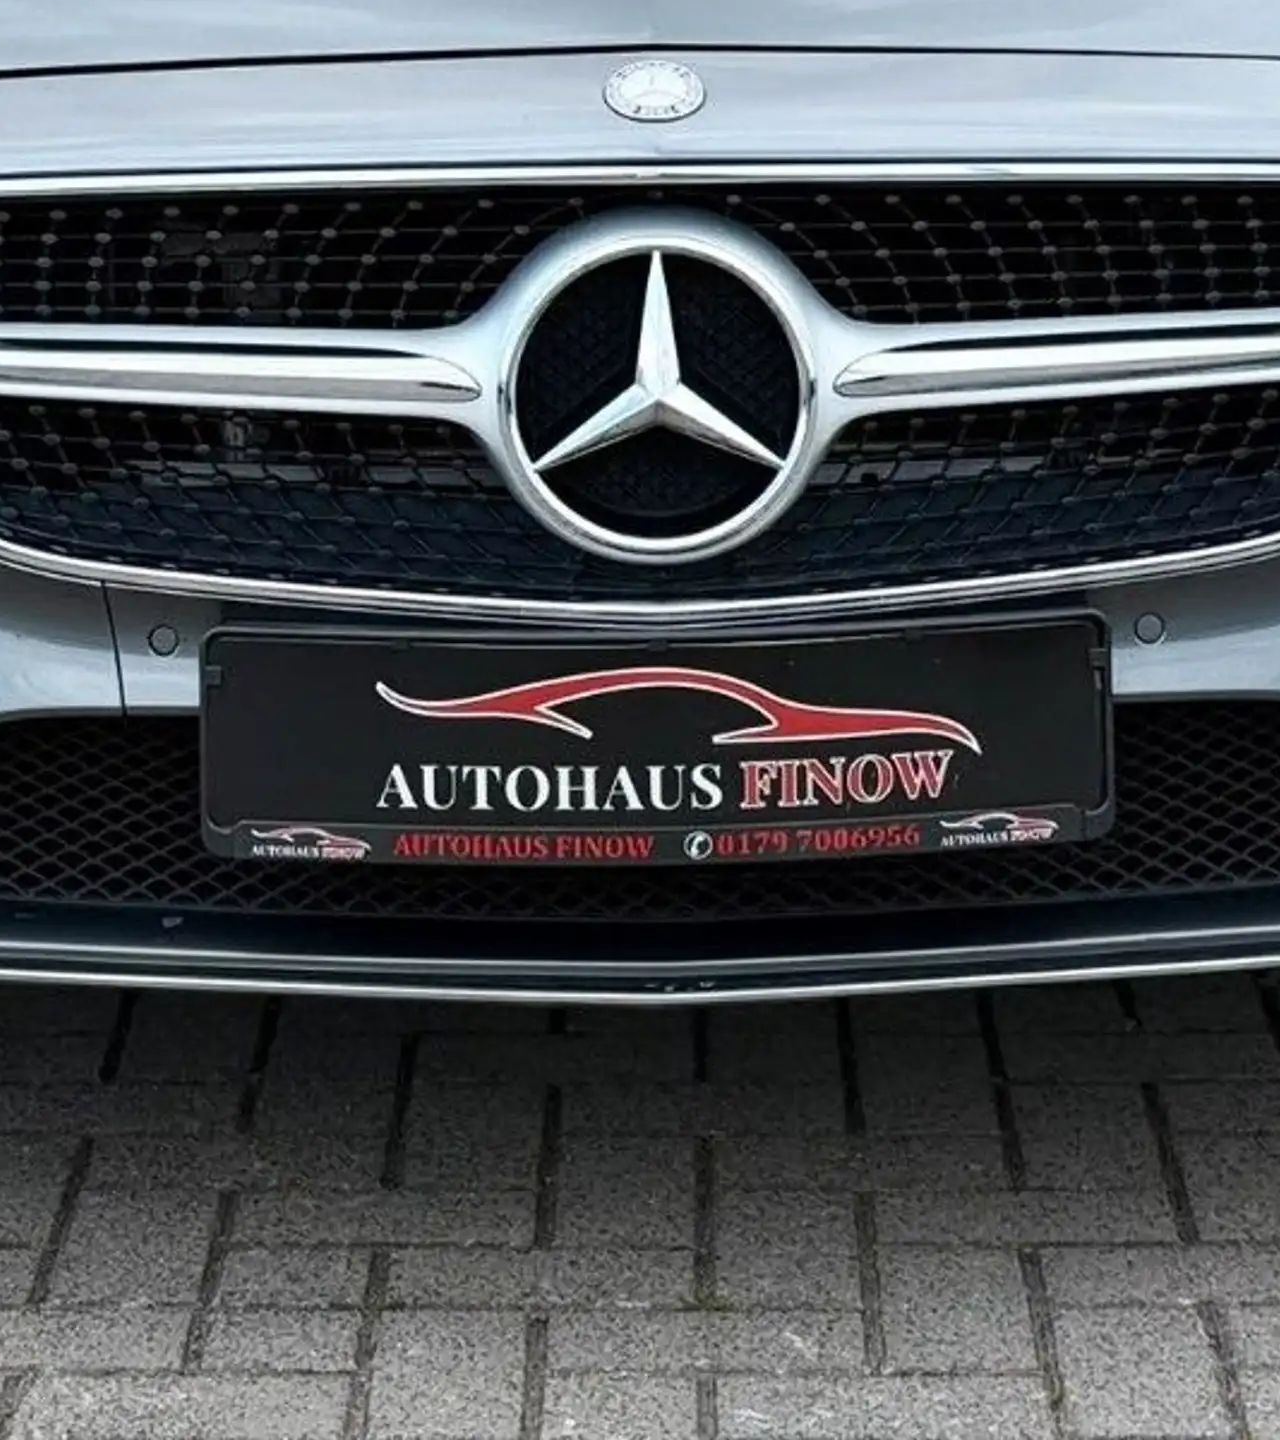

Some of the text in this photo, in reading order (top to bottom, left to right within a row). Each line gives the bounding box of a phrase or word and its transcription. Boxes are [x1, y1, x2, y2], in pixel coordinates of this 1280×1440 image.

[376, 748, 955, 812] AUTOHAUS FINOW
[392, 833, 655, 859] AUTOHAUS FINOW
[716, 823, 922, 856] 0179 7006956
